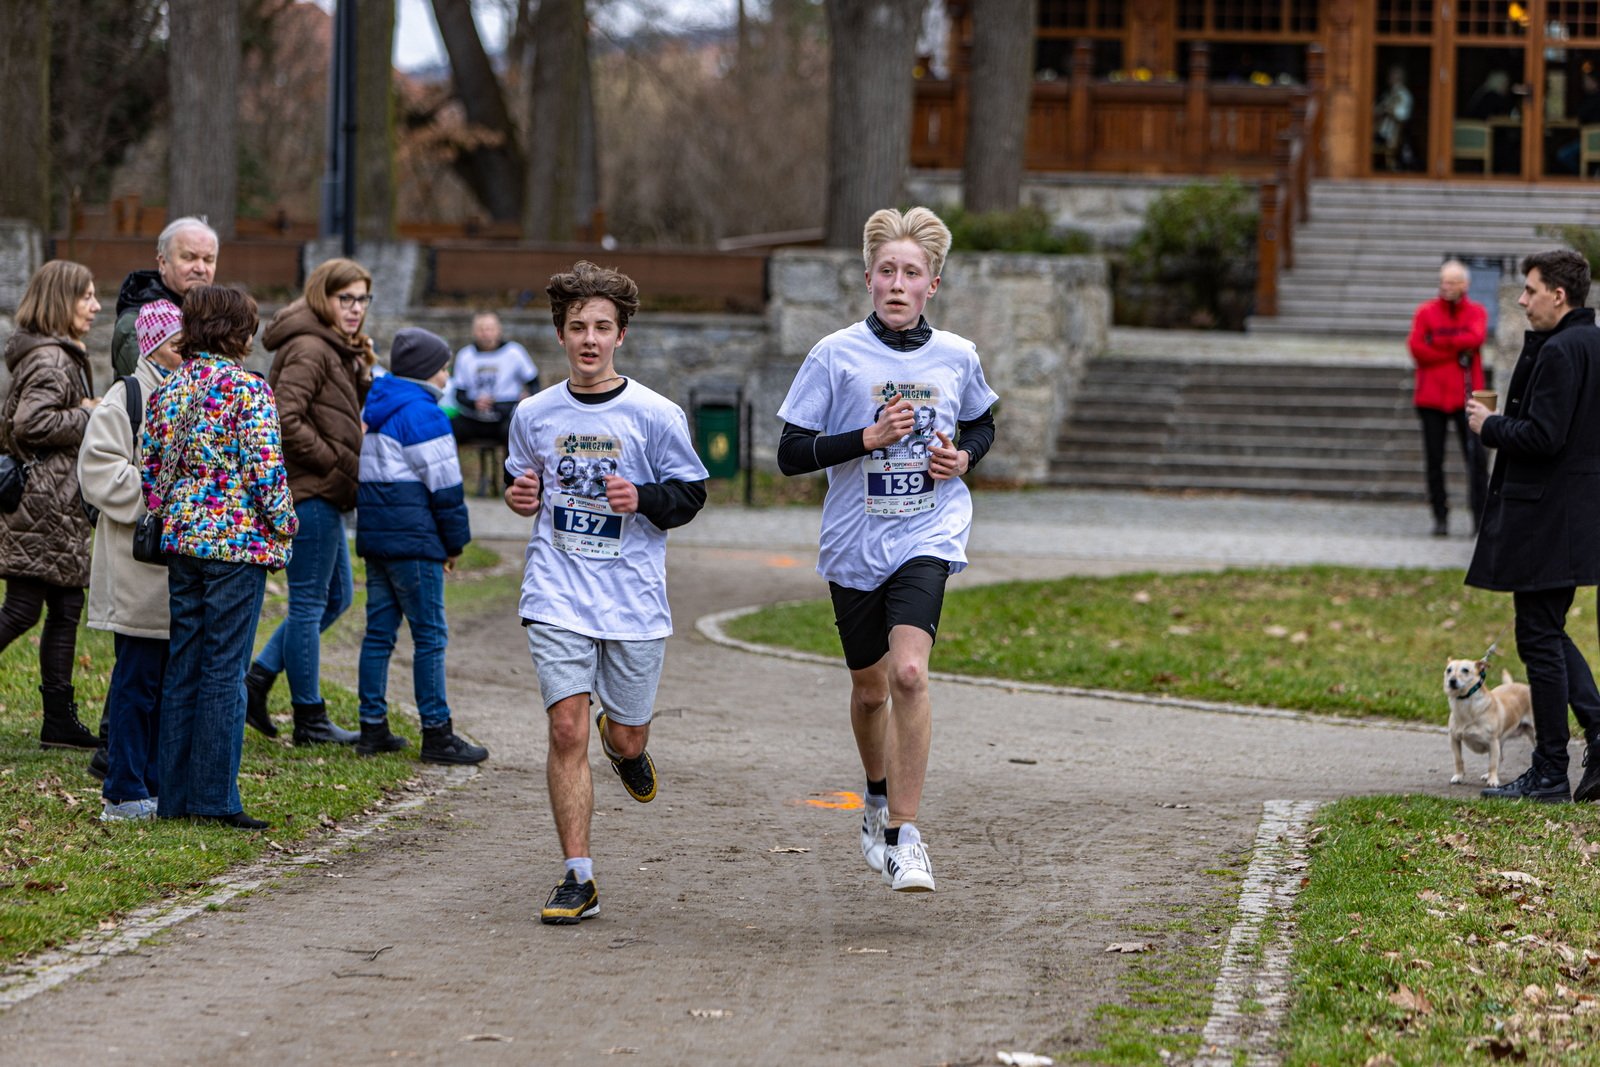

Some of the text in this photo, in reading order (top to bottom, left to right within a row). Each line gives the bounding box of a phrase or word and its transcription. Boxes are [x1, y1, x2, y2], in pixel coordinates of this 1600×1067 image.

[580, 441, 613, 451] WILCZYM
[882, 474, 925, 495] 139
[564, 509, 607, 535] 137
